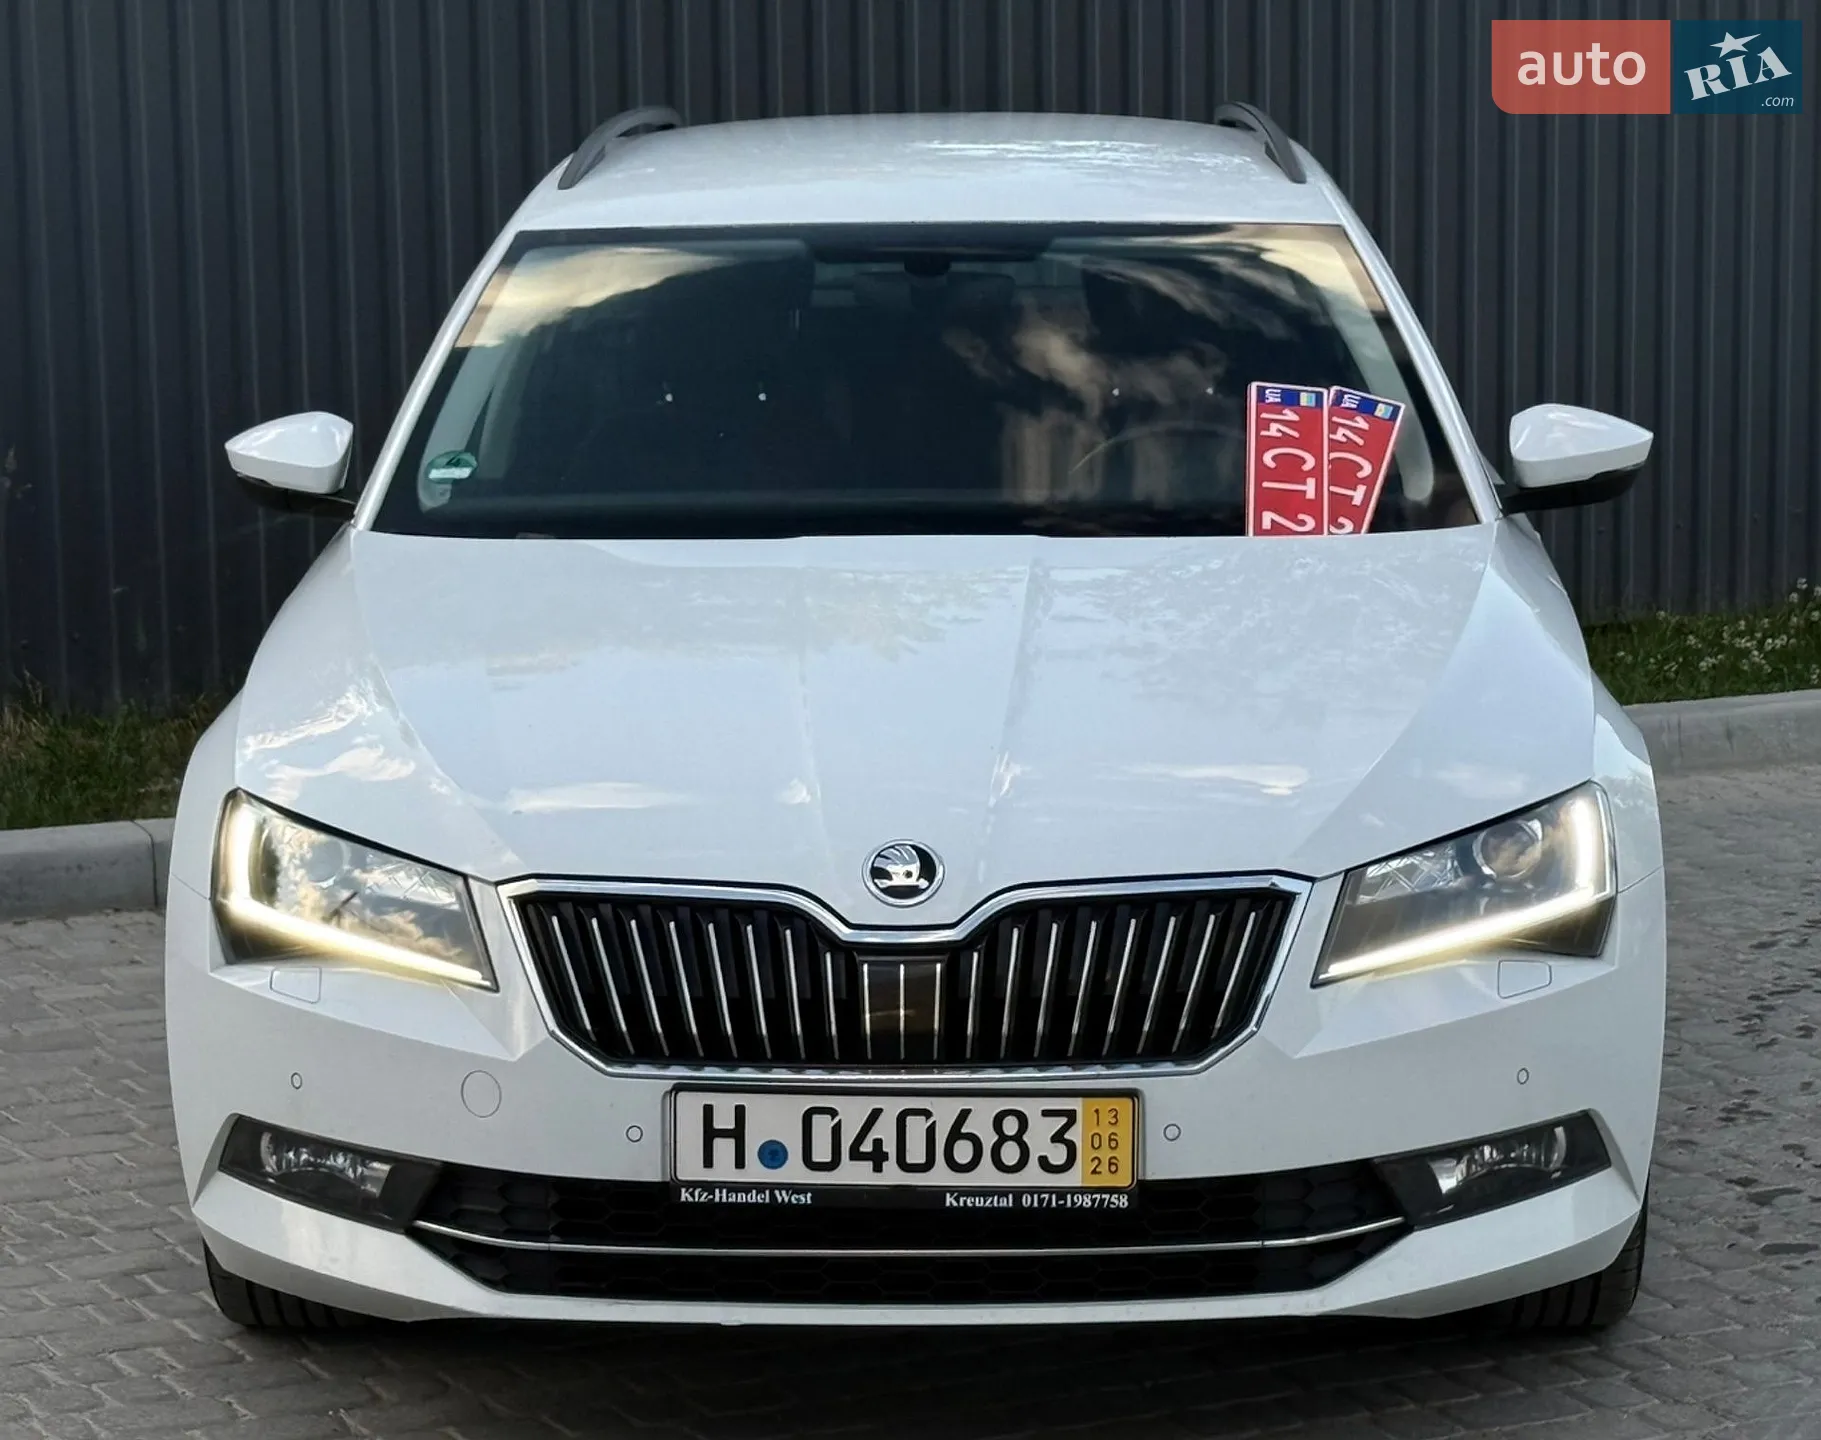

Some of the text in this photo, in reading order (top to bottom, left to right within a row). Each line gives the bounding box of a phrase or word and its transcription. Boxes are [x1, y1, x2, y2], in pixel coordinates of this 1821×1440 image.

[1264, 388, 1282, 404] UA
[1342, 394, 1361, 408] UA
[1093, 1107, 1119, 1126] 13
[702, 1103, 1078, 1174] H 040683
[1090, 1132, 1119, 1150] 06
[1090, 1156, 1120, 1175] 26
[679, 1187, 812, 1204] Kfz-Handel West
[945, 1192, 1129, 1208] Kreuztal 0171-1987758
